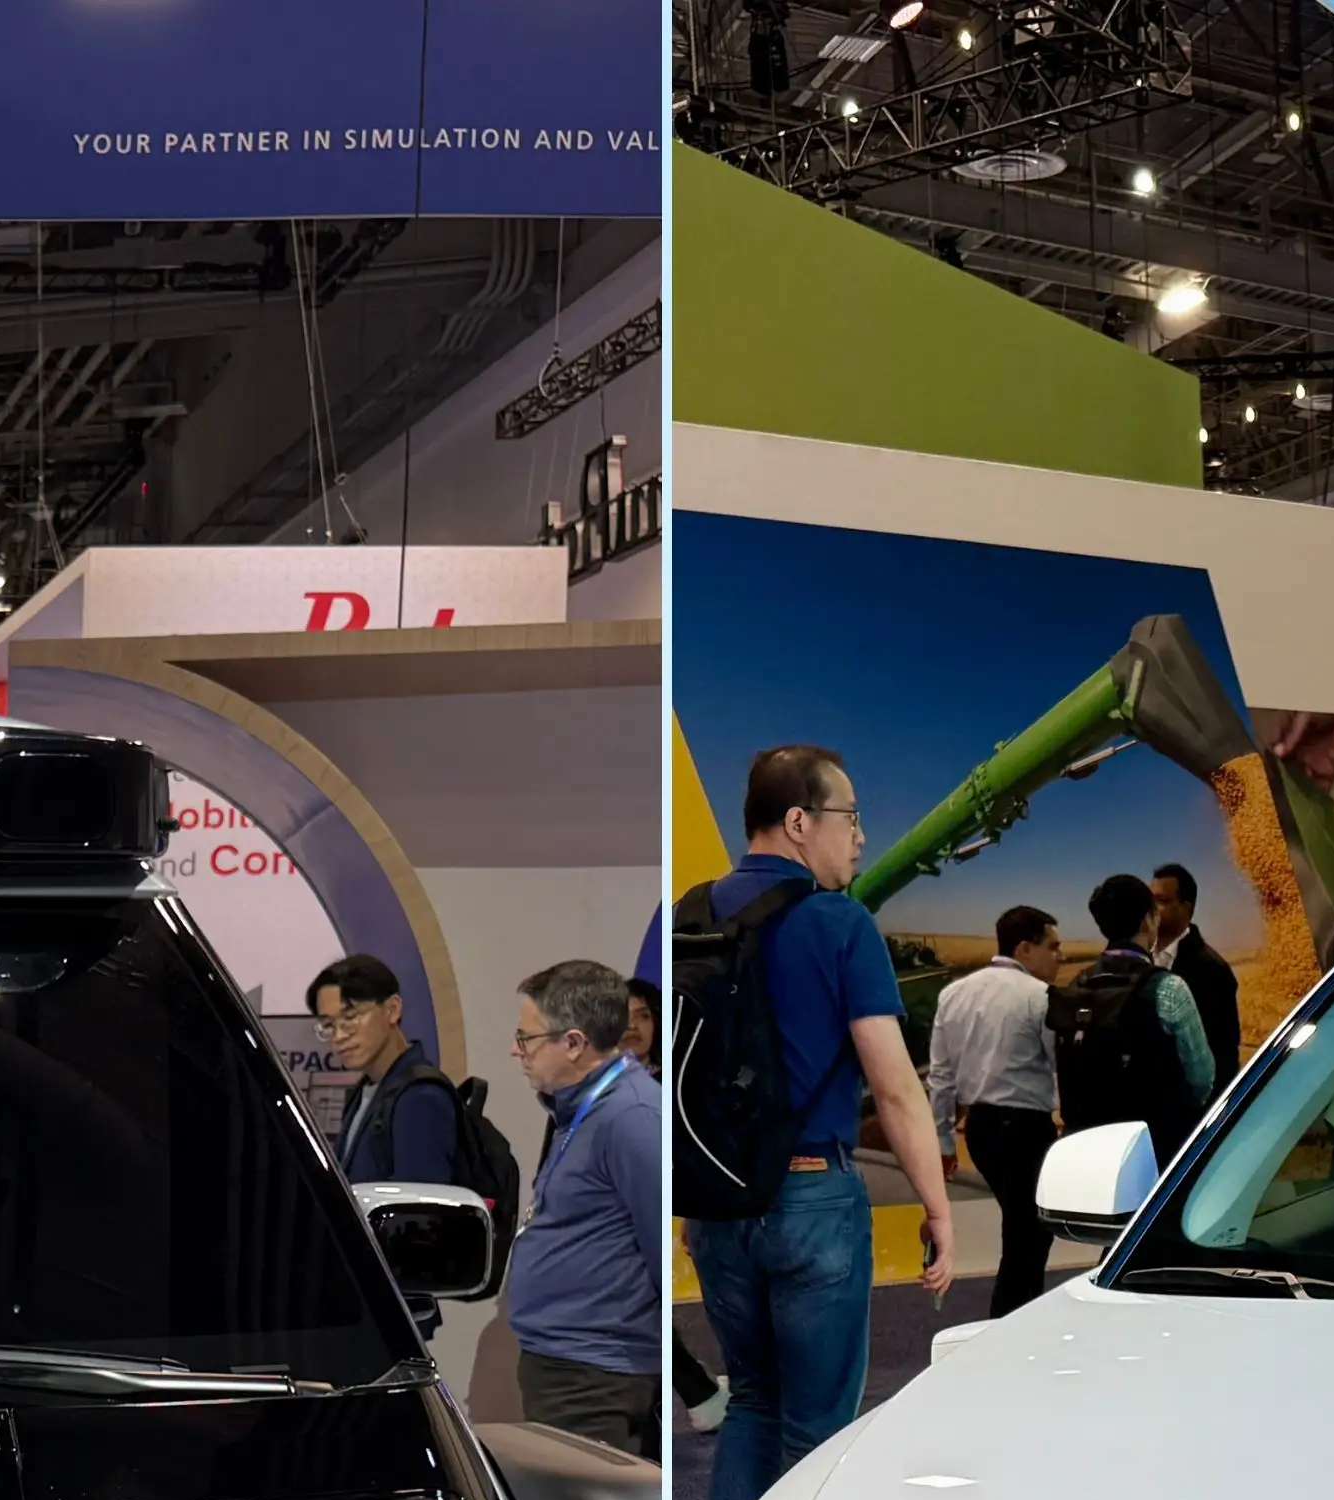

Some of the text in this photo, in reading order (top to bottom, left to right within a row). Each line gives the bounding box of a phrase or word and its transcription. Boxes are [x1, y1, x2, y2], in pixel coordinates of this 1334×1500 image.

[73, 133, 151, 155] YOUR
[164, 131, 289, 154] PARTNER
[303, 130, 331, 151] IN
[344, 127, 520, 150] SIMULATION
[533, 129, 595, 151] AND
[152, 852, 197, 878] nd
[280, 1051, 346, 1073] PAC
